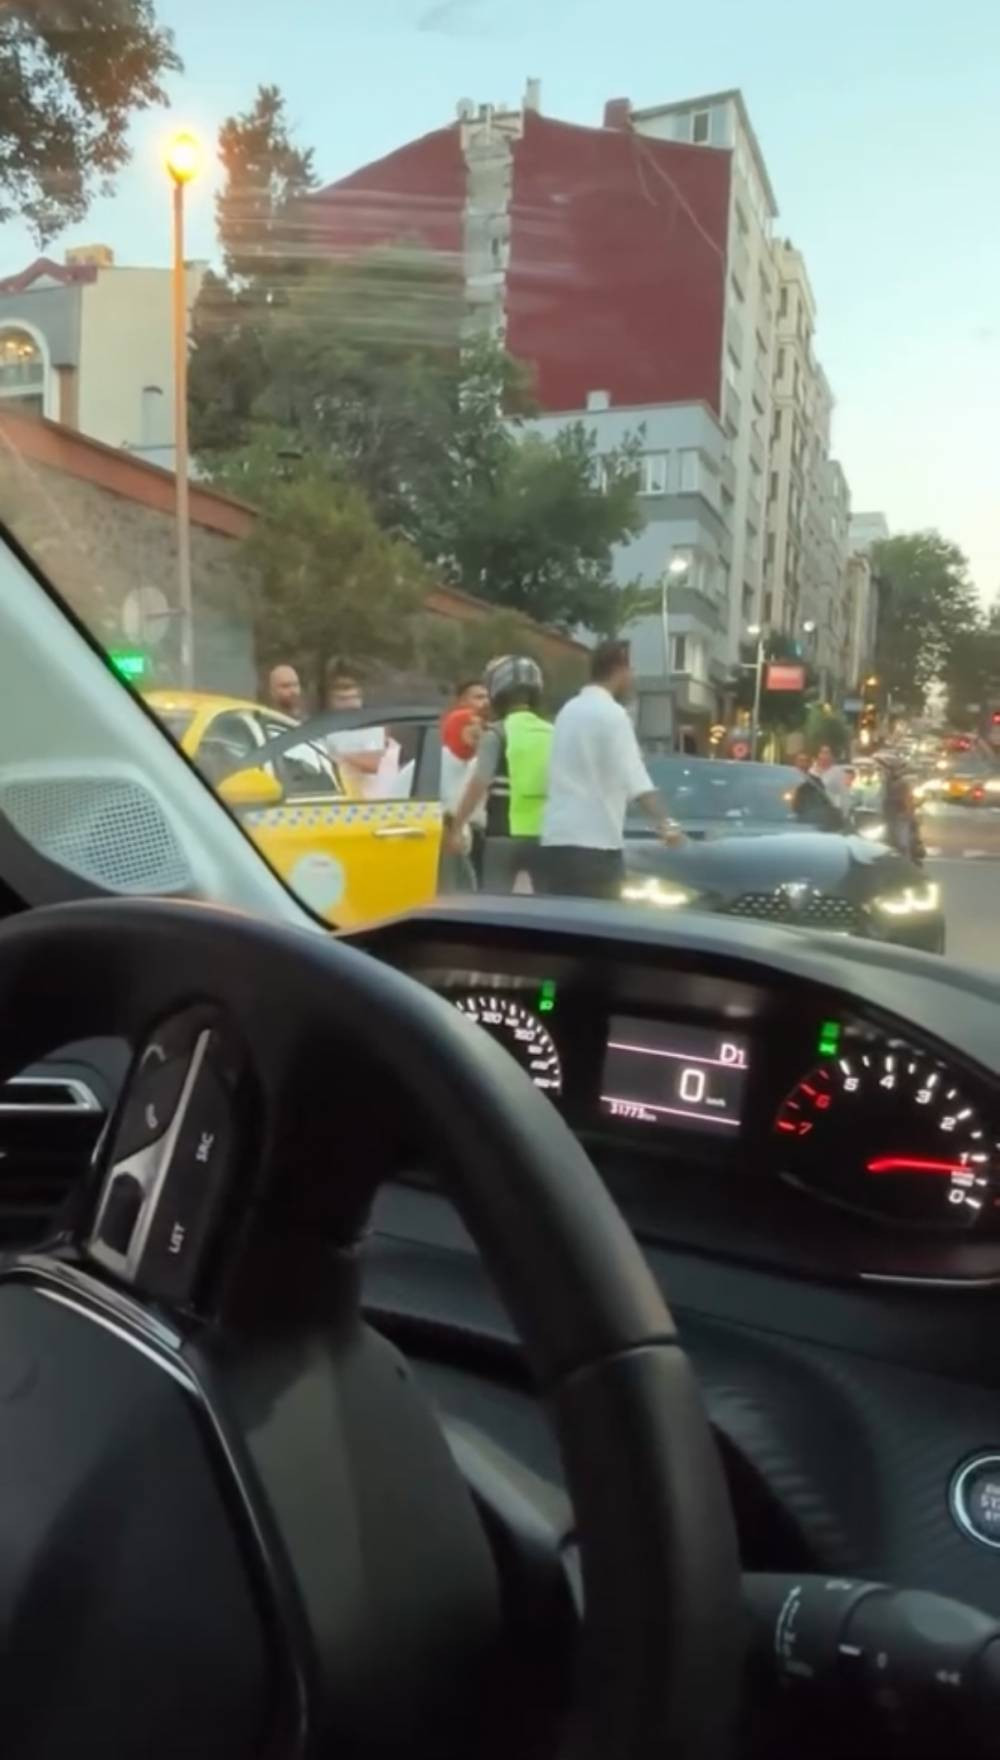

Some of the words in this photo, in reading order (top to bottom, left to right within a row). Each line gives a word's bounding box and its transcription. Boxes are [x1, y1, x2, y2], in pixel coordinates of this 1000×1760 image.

[680, 1068, 705, 1103] 0
[843, 1076, 860, 1092] 5
[879, 1074, 895, 1089] 4
[915, 1088, 932, 1104] 3
[799, 1120, 813, 1135] 7
[940, 1116, 956, 1131] 2
[195, 1132, 214, 1162] SRC
[948, 1188, 965, 1204] 0
[168, 1221, 185, 1253] LIST
